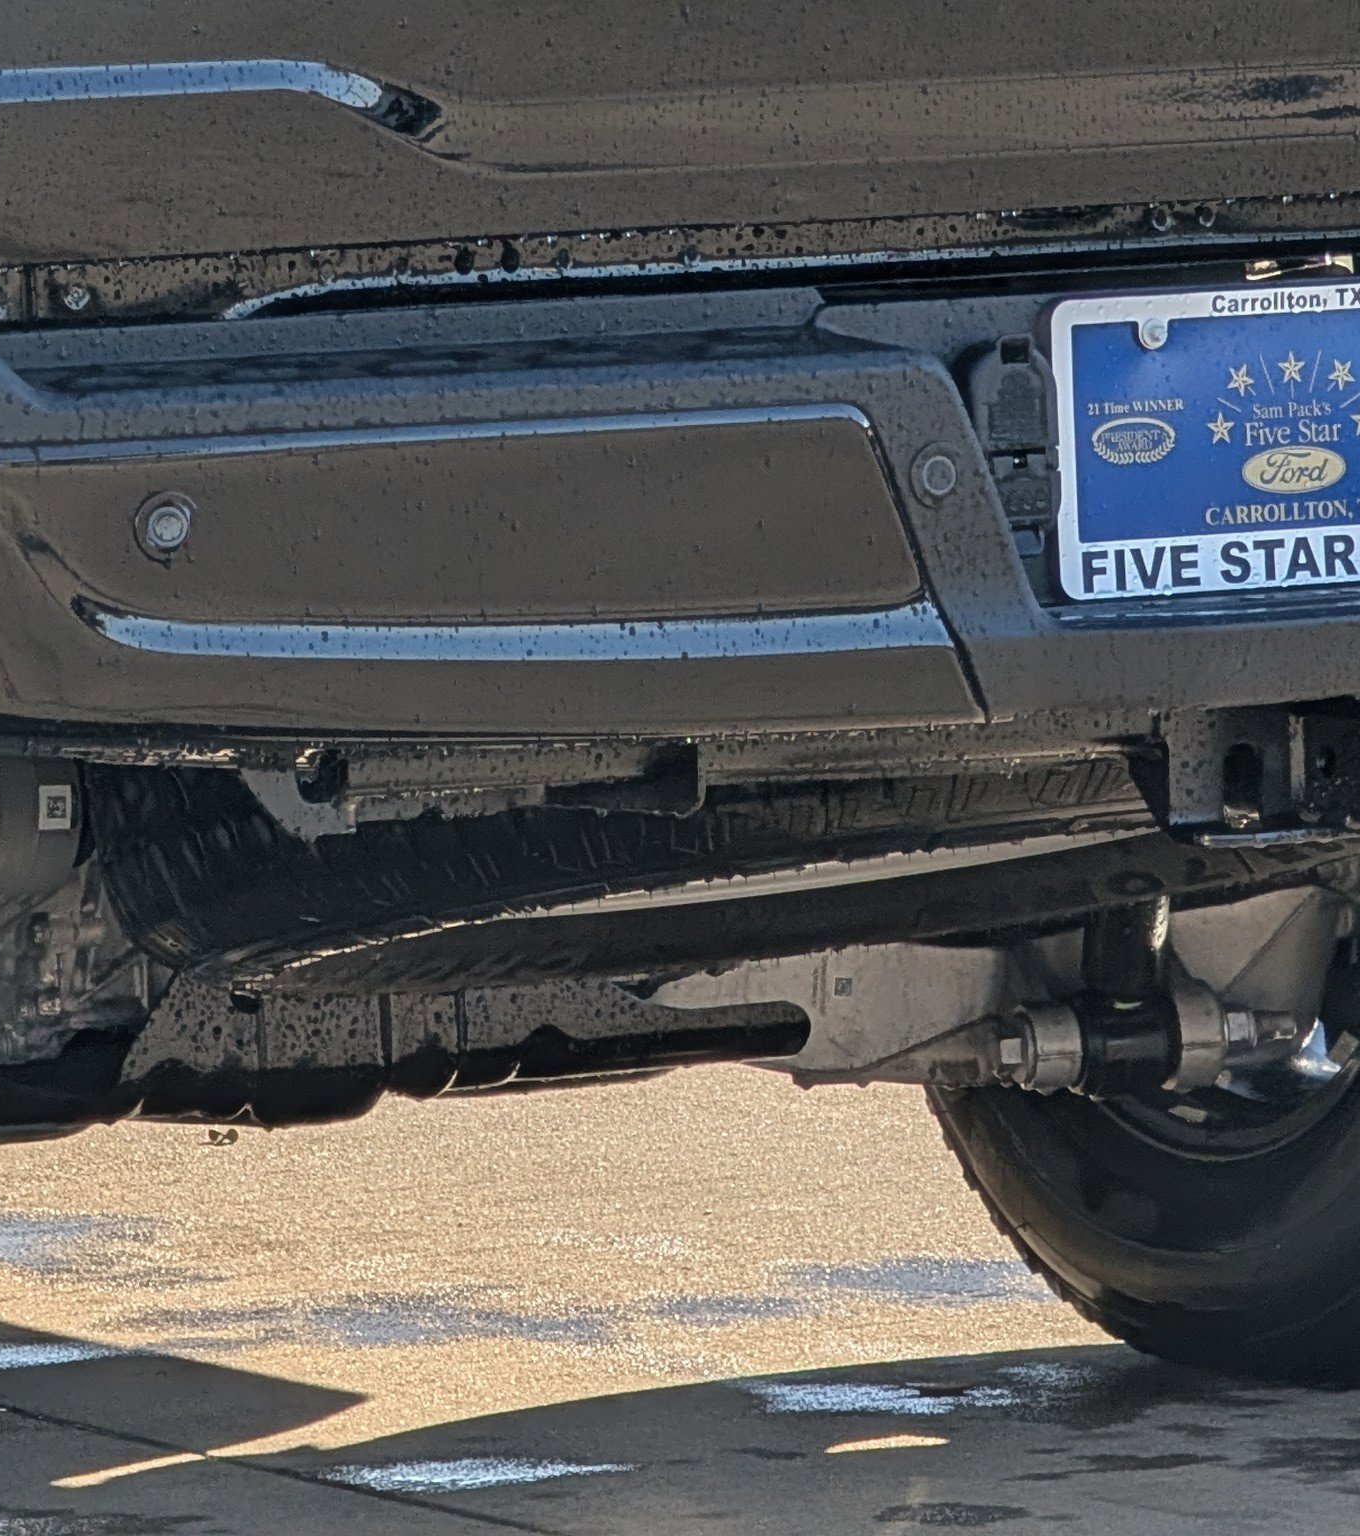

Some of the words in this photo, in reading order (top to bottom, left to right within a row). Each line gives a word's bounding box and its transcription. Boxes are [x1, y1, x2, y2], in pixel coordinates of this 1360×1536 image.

[1211, 291, 1328, 313] Carrollton,
[1087, 402, 1100, 416] 21
[1103, 402, 1130, 415] Time
[1131, 398, 1185, 412] WINNER
[1252, 403, 1283, 420] Sam
[1288, 399, 1332, 418] Pack's
[1244, 421, 1290, 446] Five
[1298, 419, 1342, 443] Star
[1259, 451, 1329, 484] Ford
[1205, 498, 1353, 526] CARROLLTON,
[1081, 544, 1201, 594] FIVE
[1219, 534, 1358, 586] STAR
